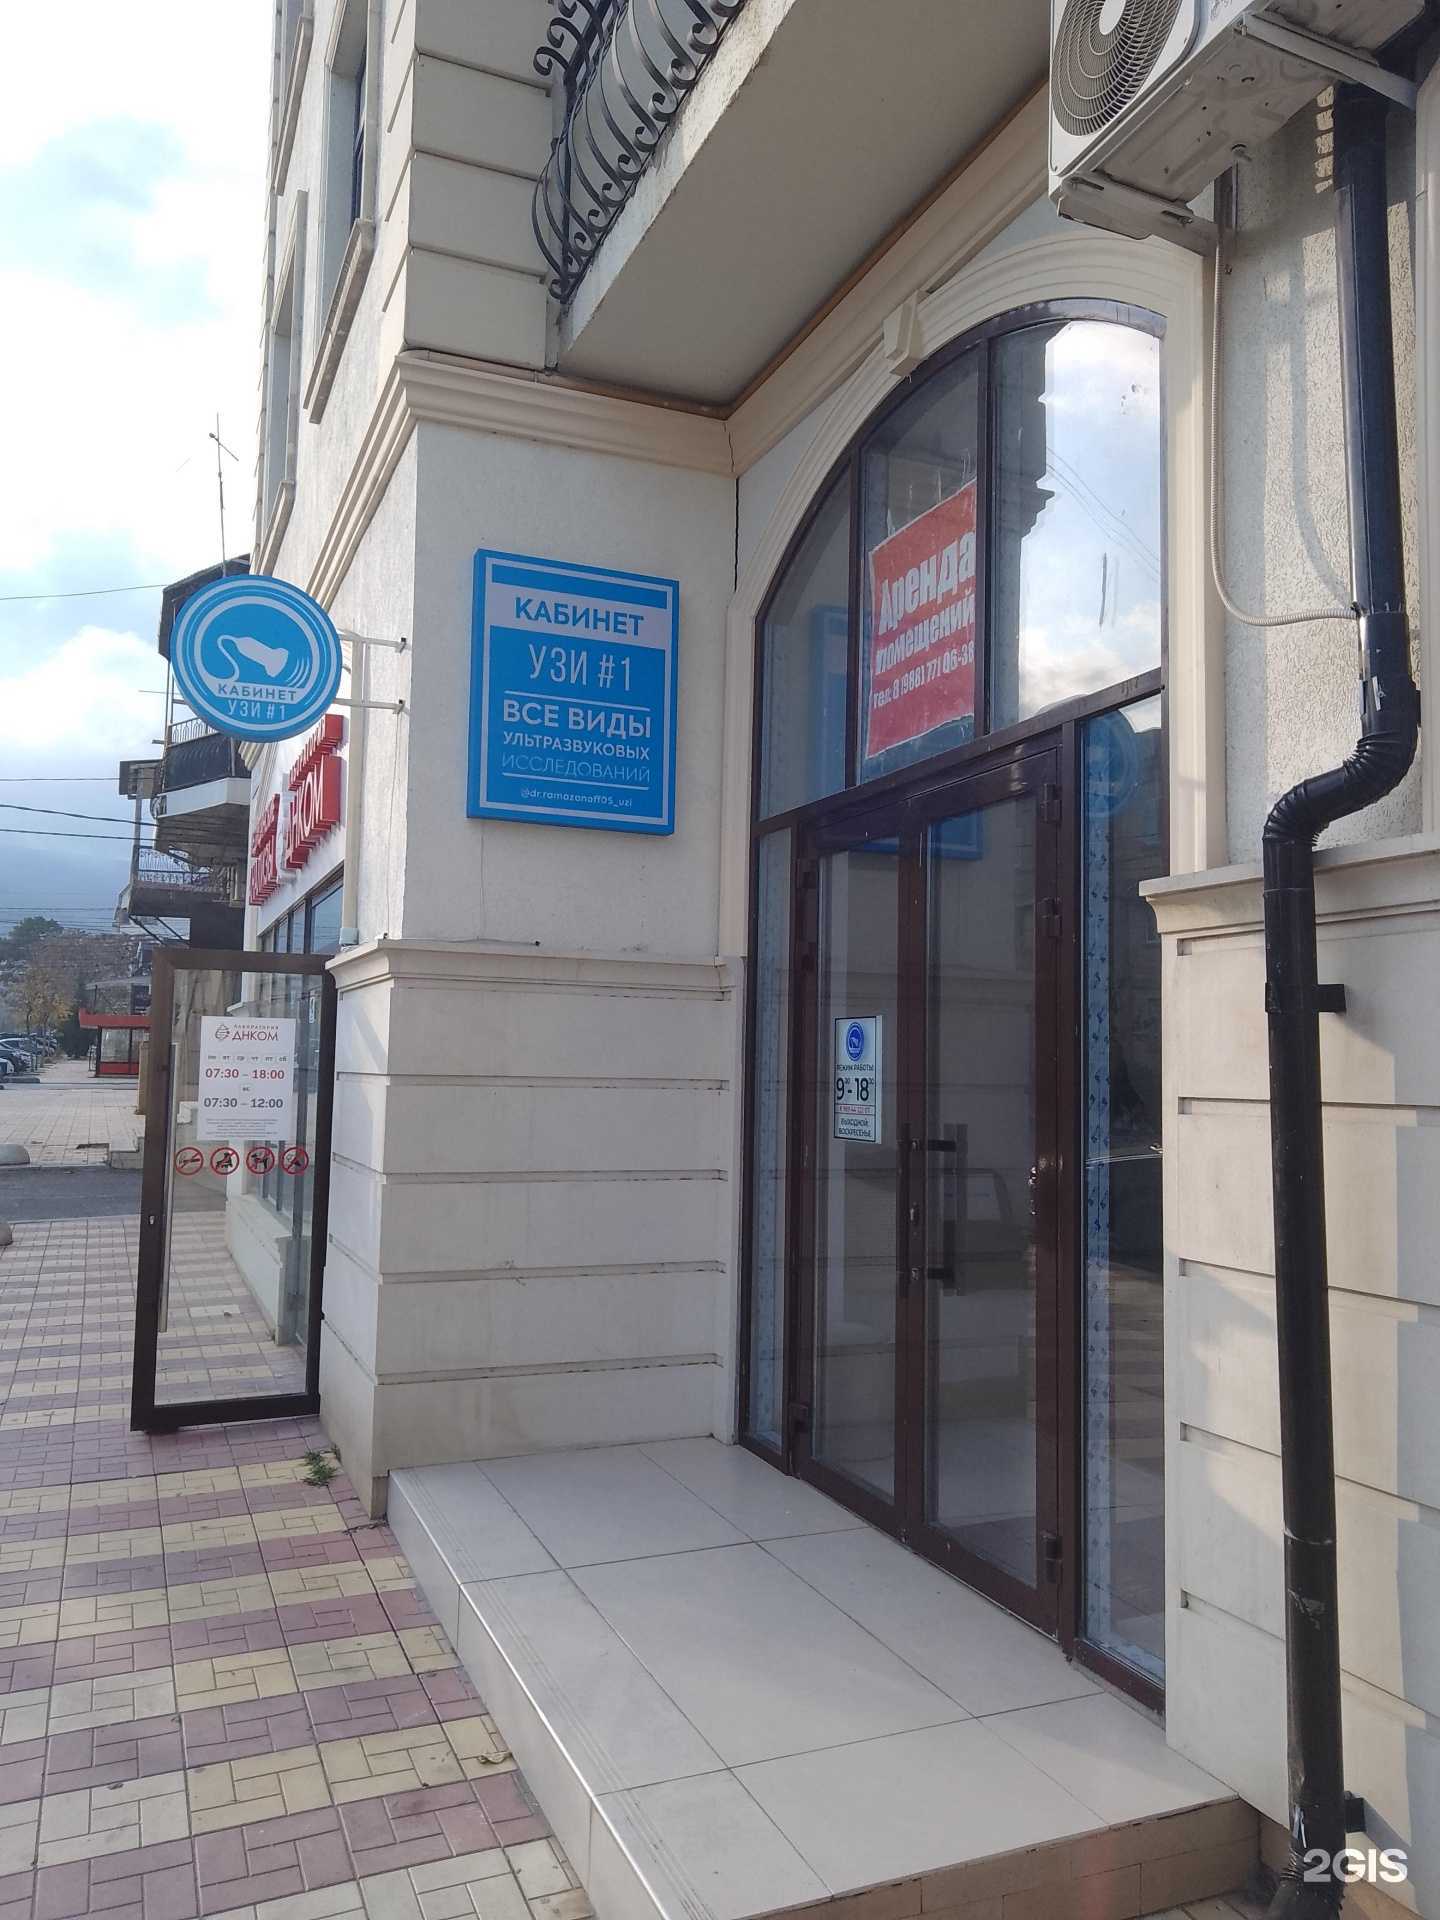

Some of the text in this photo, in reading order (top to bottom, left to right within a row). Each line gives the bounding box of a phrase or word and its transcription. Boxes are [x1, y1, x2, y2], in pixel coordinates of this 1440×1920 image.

[878, 531, 975, 636] Аренда
[515, 597, 644, 636] КАБИНЕТ
[875, 590, 975, 675] помещений
[529, 643, 631, 691] УЗИ #1
[218, 683, 297, 701] КАБИНЕТ
[228, 699, 286, 720] УЗИ #1
[503, 700, 651, 739] ВСЕ ВИДЫ
[503, 731, 650, 761] УЛЬТРАЗВУКОВЫХ
[502, 753, 650, 783] ИССЛЕДОВАНИЙ
[232, 1031, 279, 1041] ДНКОМ
[206, 1068, 239, 1079] 07:30
[252, 1069, 285, 1080] 18:00
[203, 1097, 238, 1109] 07:30
[250, 1098, 284, 1109] 12:00
